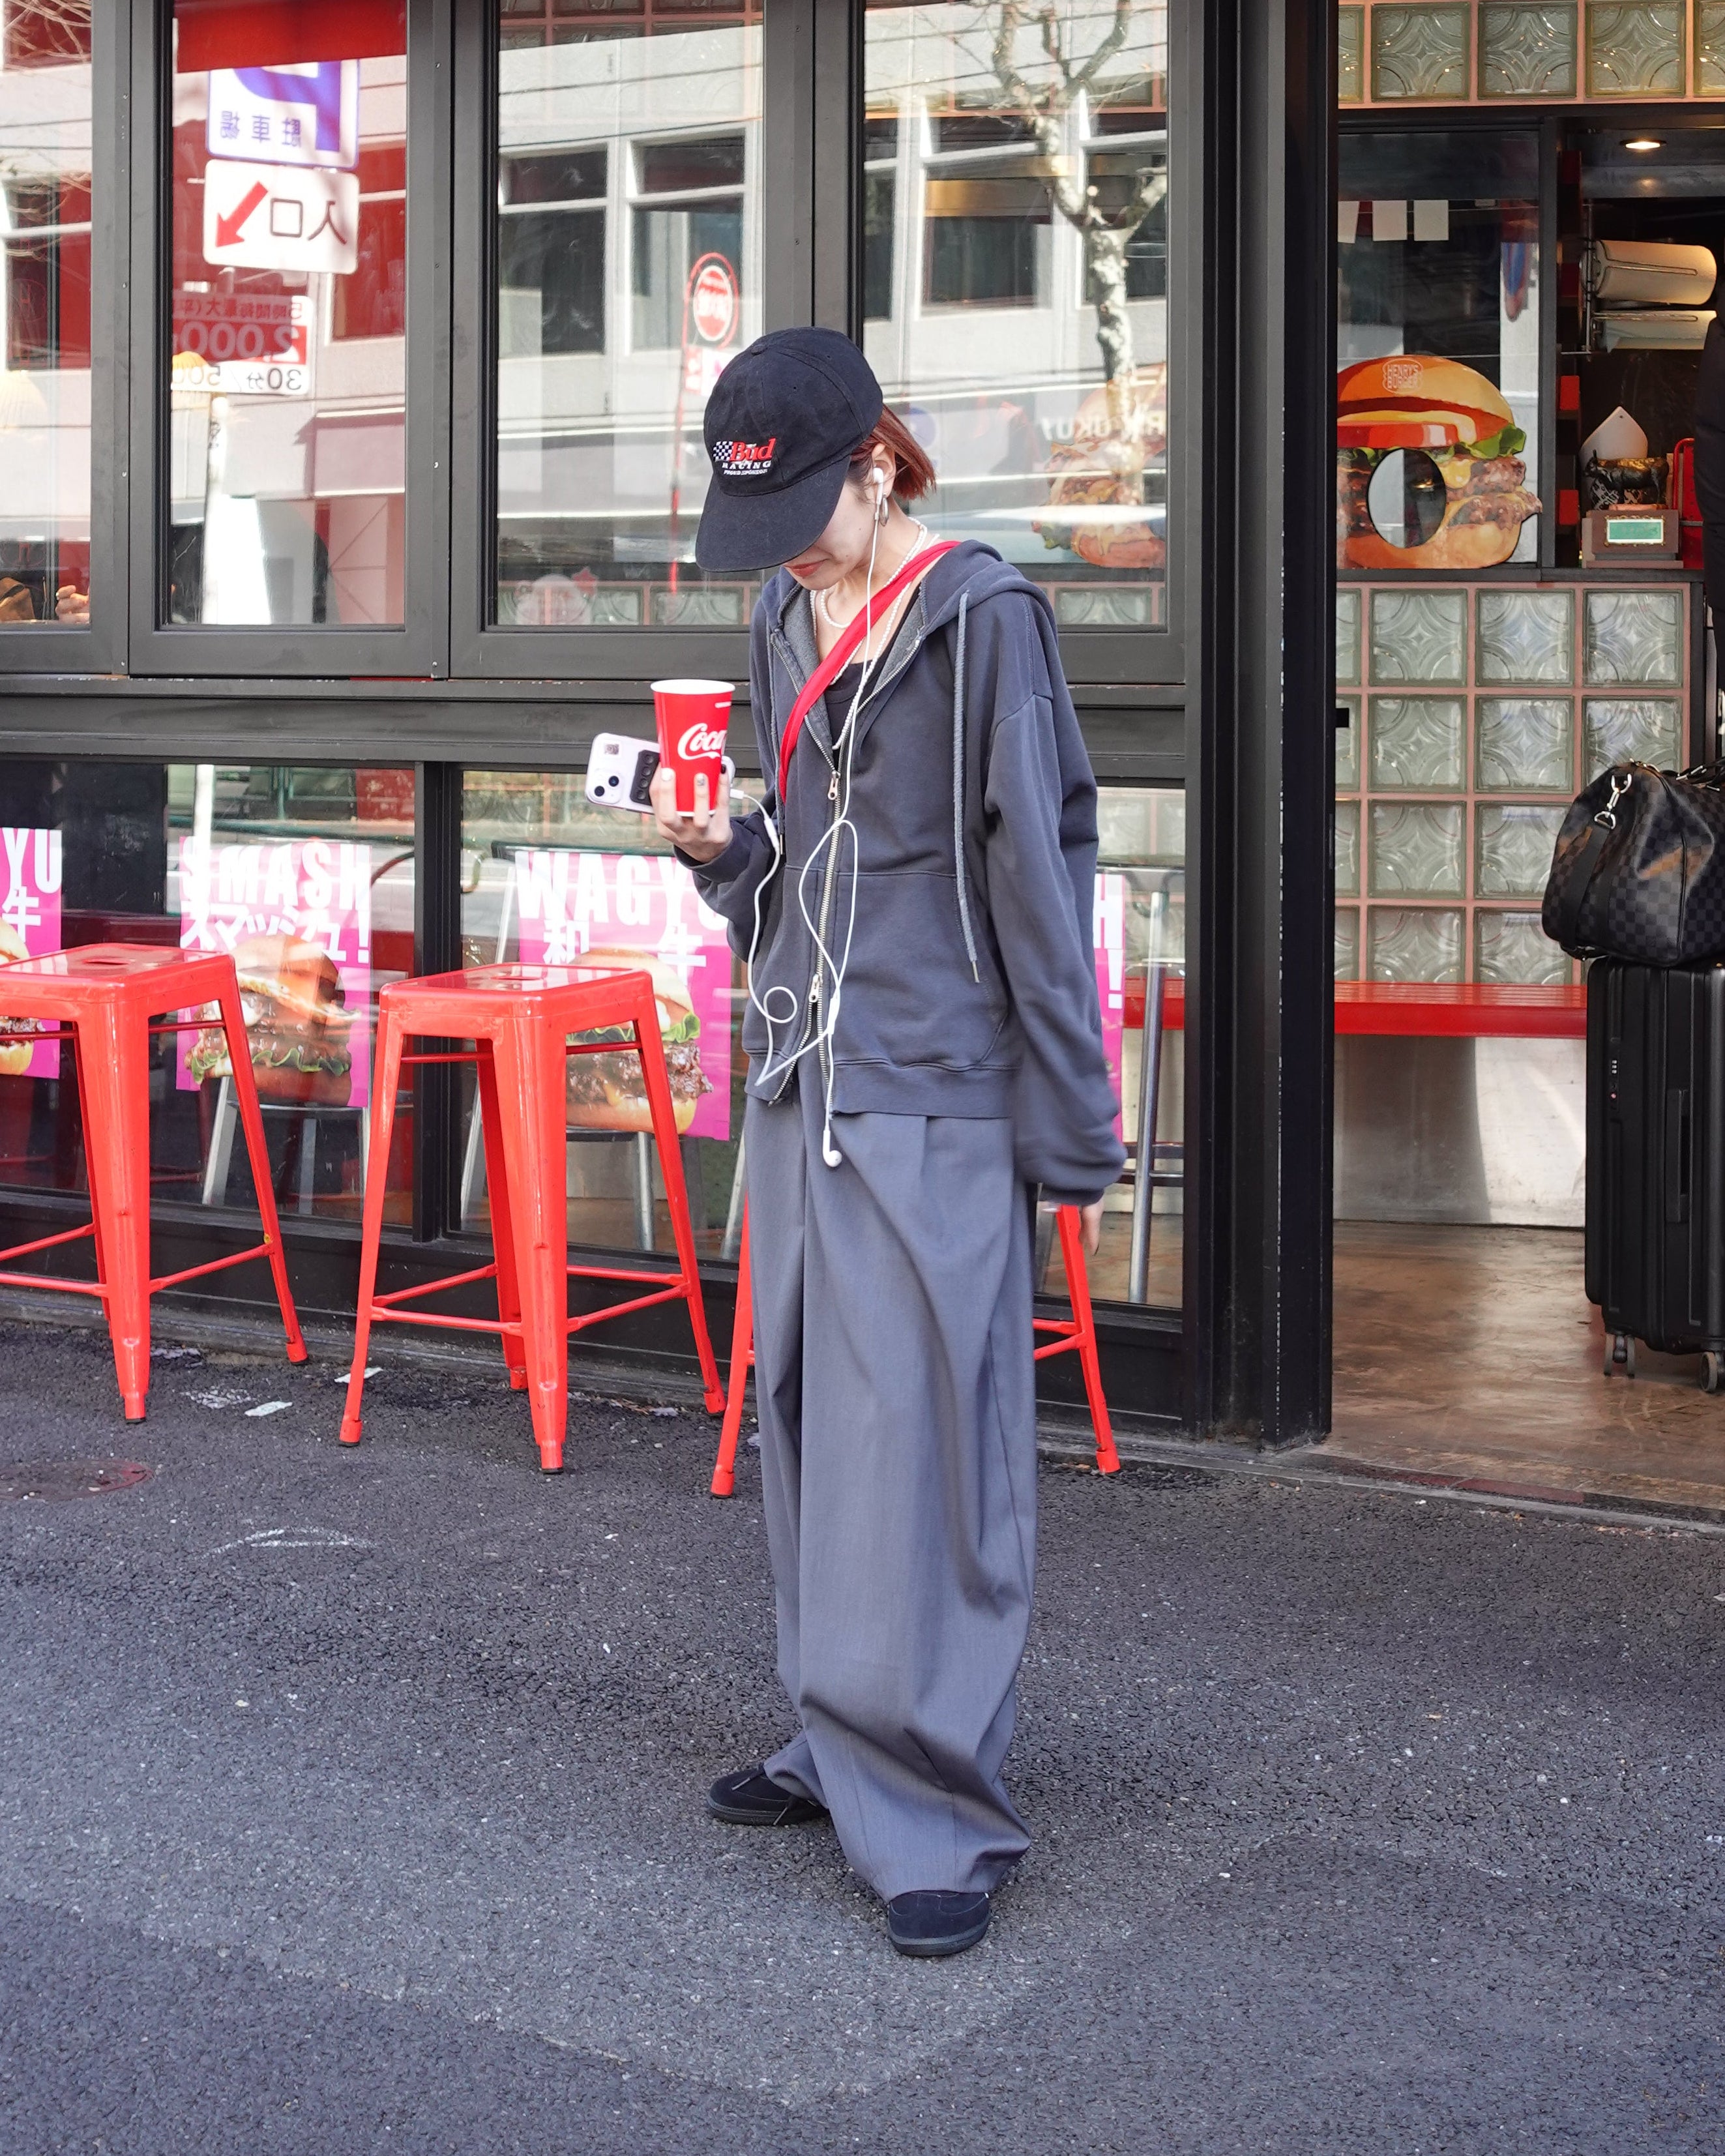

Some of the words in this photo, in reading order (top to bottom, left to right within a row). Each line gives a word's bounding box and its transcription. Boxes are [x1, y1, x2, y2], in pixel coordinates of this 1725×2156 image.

[730, 437, 776, 462] Bud
[722, 460, 772, 469] RACING
[181, 836, 371, 911] SMASH
